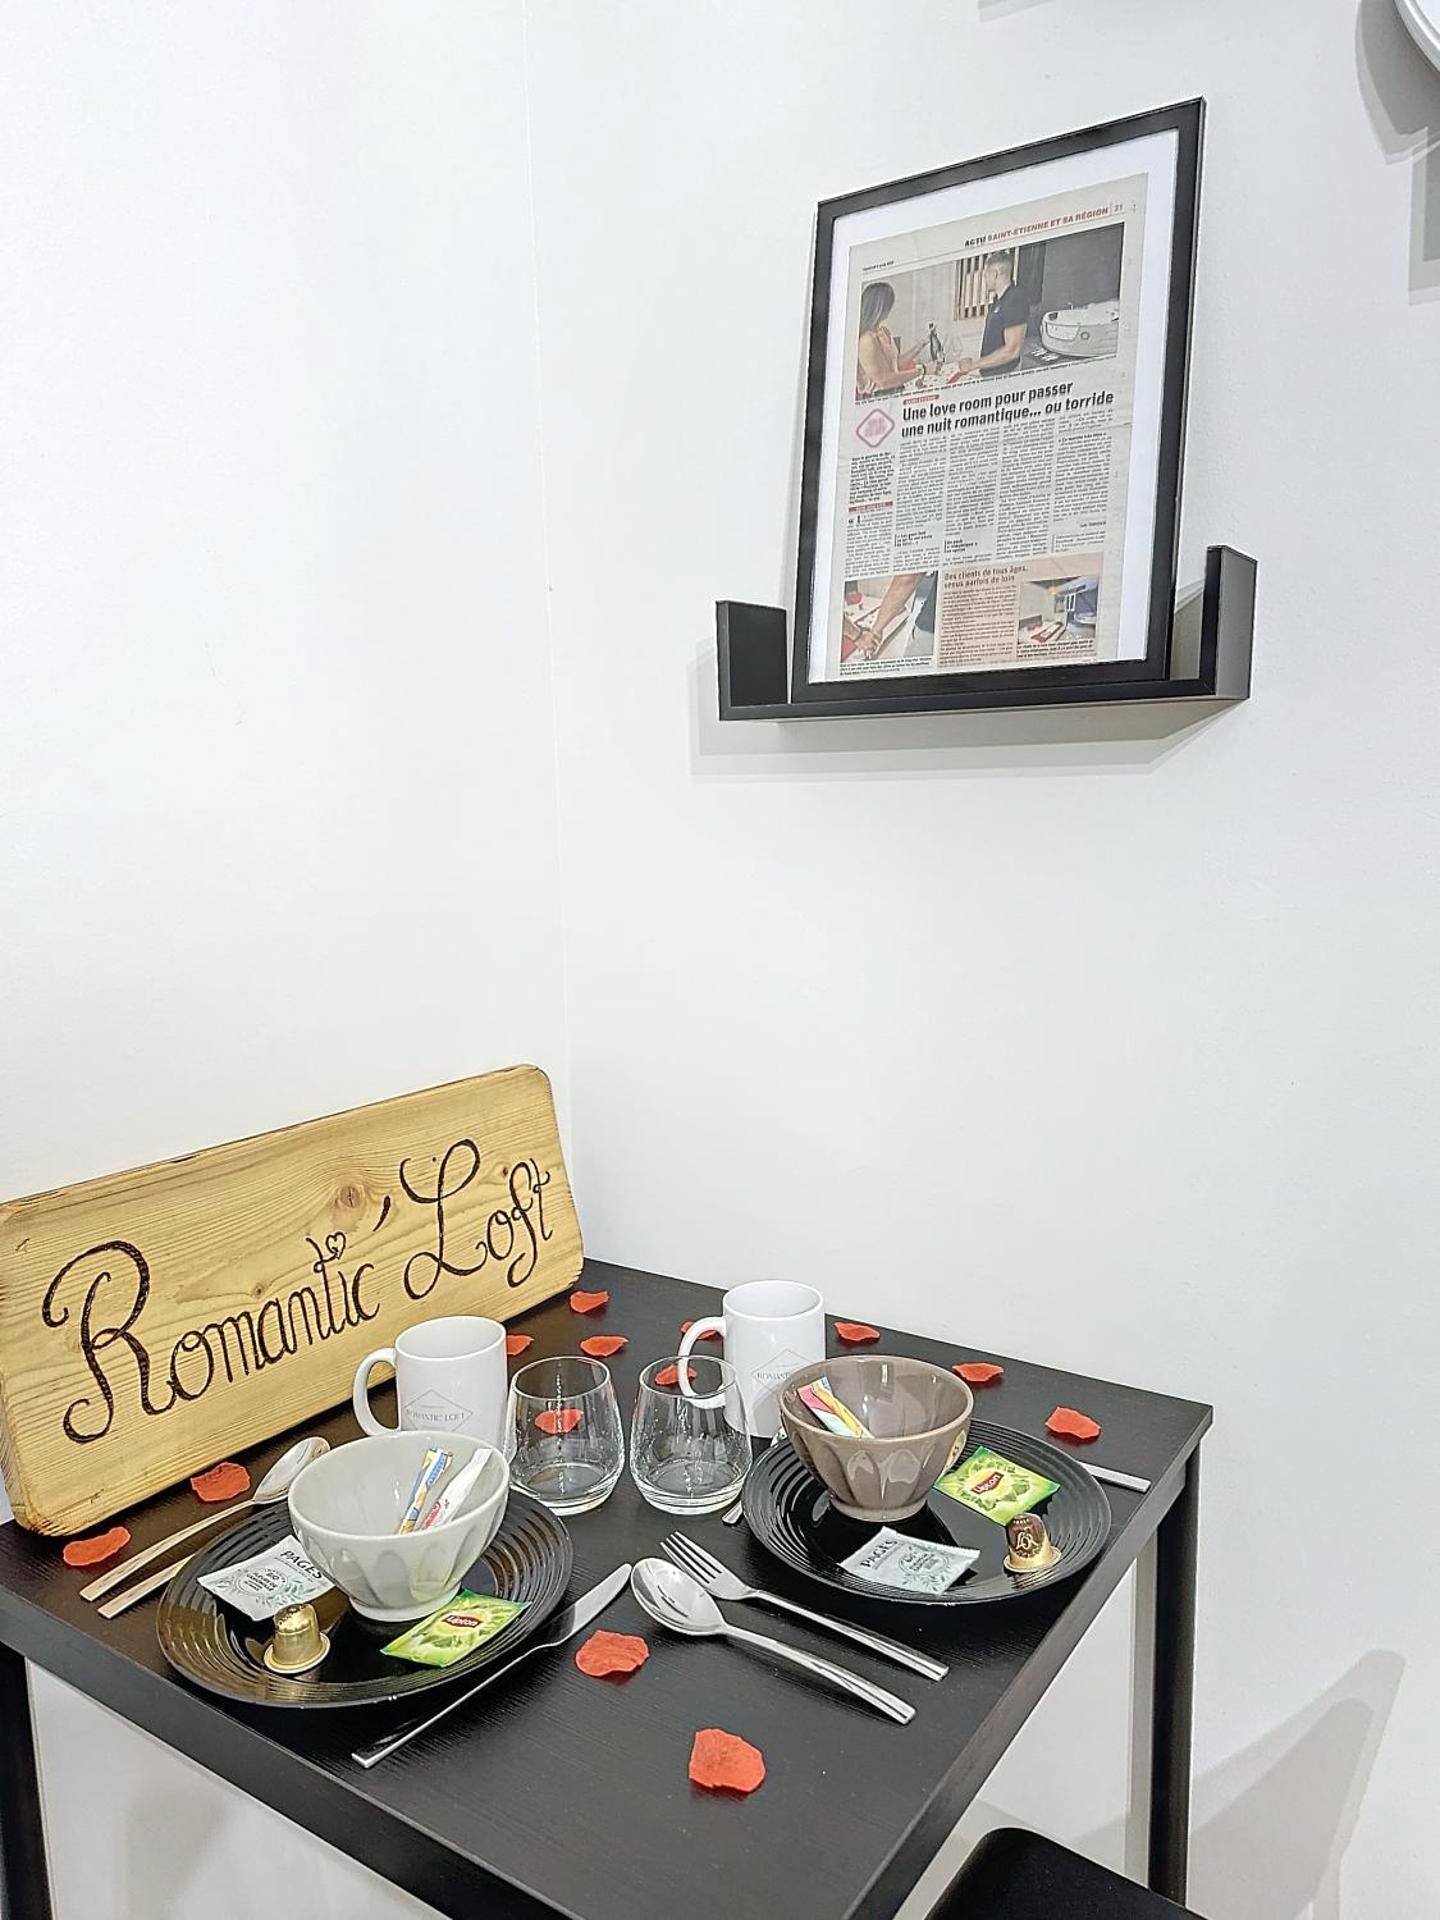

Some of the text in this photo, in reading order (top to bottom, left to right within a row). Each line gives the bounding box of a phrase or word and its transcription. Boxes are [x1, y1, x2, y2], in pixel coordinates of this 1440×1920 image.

[964, 235, 986, 247] ACTU
[1075, 206, 1109, 223] RÉGION
[901, 423, 924, 438] une
[926, 417, 951, 433] nuit
[954, 405, 1042, 429] romantique...
[1045, 402, 1062, 414] ou
[1065, 390, 1114, 411] torride
[902, 382, 1074, 422] Une love room pour passer
[399, 1139, 554, 1299] Loft
[446, 1614, 479, 1628] Lipton
